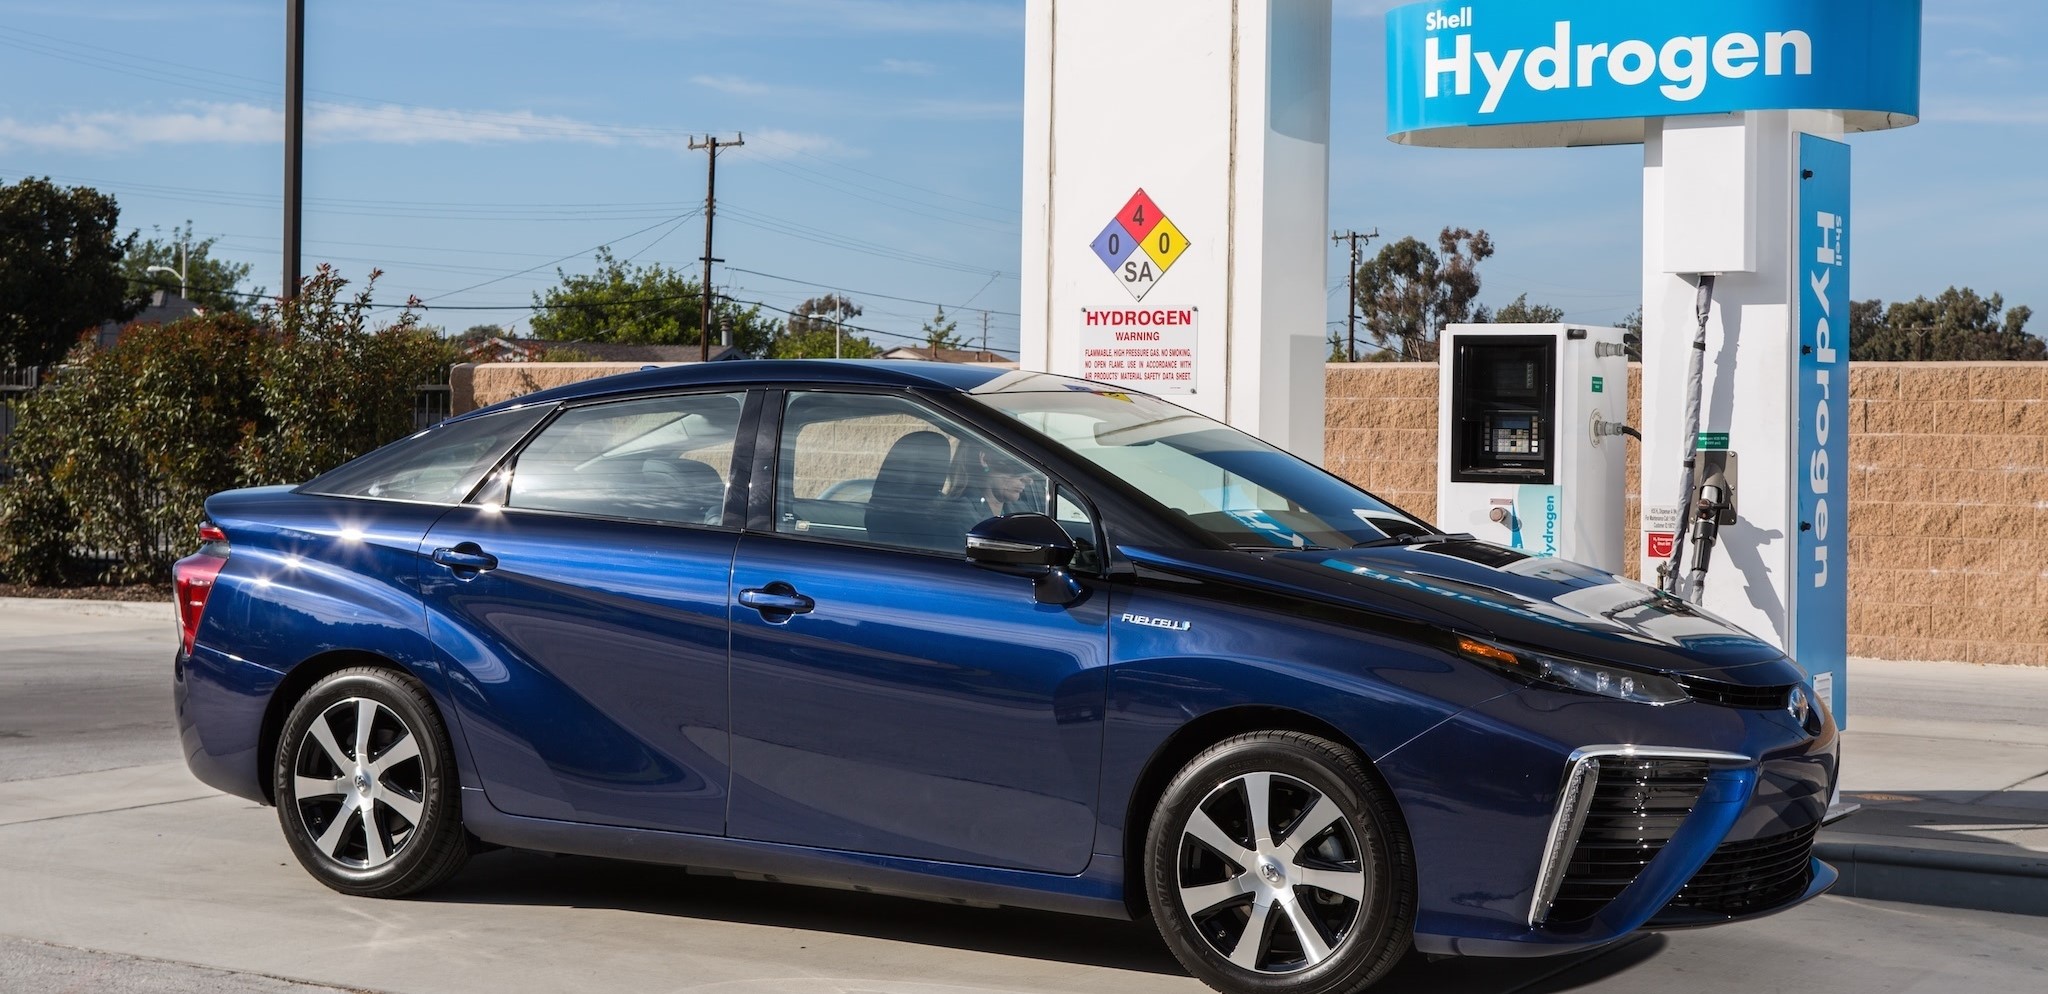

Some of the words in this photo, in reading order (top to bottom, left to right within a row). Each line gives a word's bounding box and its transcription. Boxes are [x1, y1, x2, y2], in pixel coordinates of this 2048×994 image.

[1426, 7, 1472, 31] Shell
[1425, 20, 1812, 113] Hydrogen
[1132, 205, 1144, 226] 4
[1108, 234, 1120, 255] 0
[1159, 232, 1170, 254] 0
[1124, 262, 1153, 282] SA
[1086, 310, 1191, 326] HYDROGEN
[1115, 332, 1160, 341] WARNING
[1114, 349, 1125, 357] HIGH
[1126, 349, 1149, 357] PRESSURE
[1120, 372, 1142, 380] MATERIAL
[1144, 372, 1161, 380] SAFETY
[1162, 372, 1174, 380] DATA
[1810, 211, 1836, 588] Hydrogen
